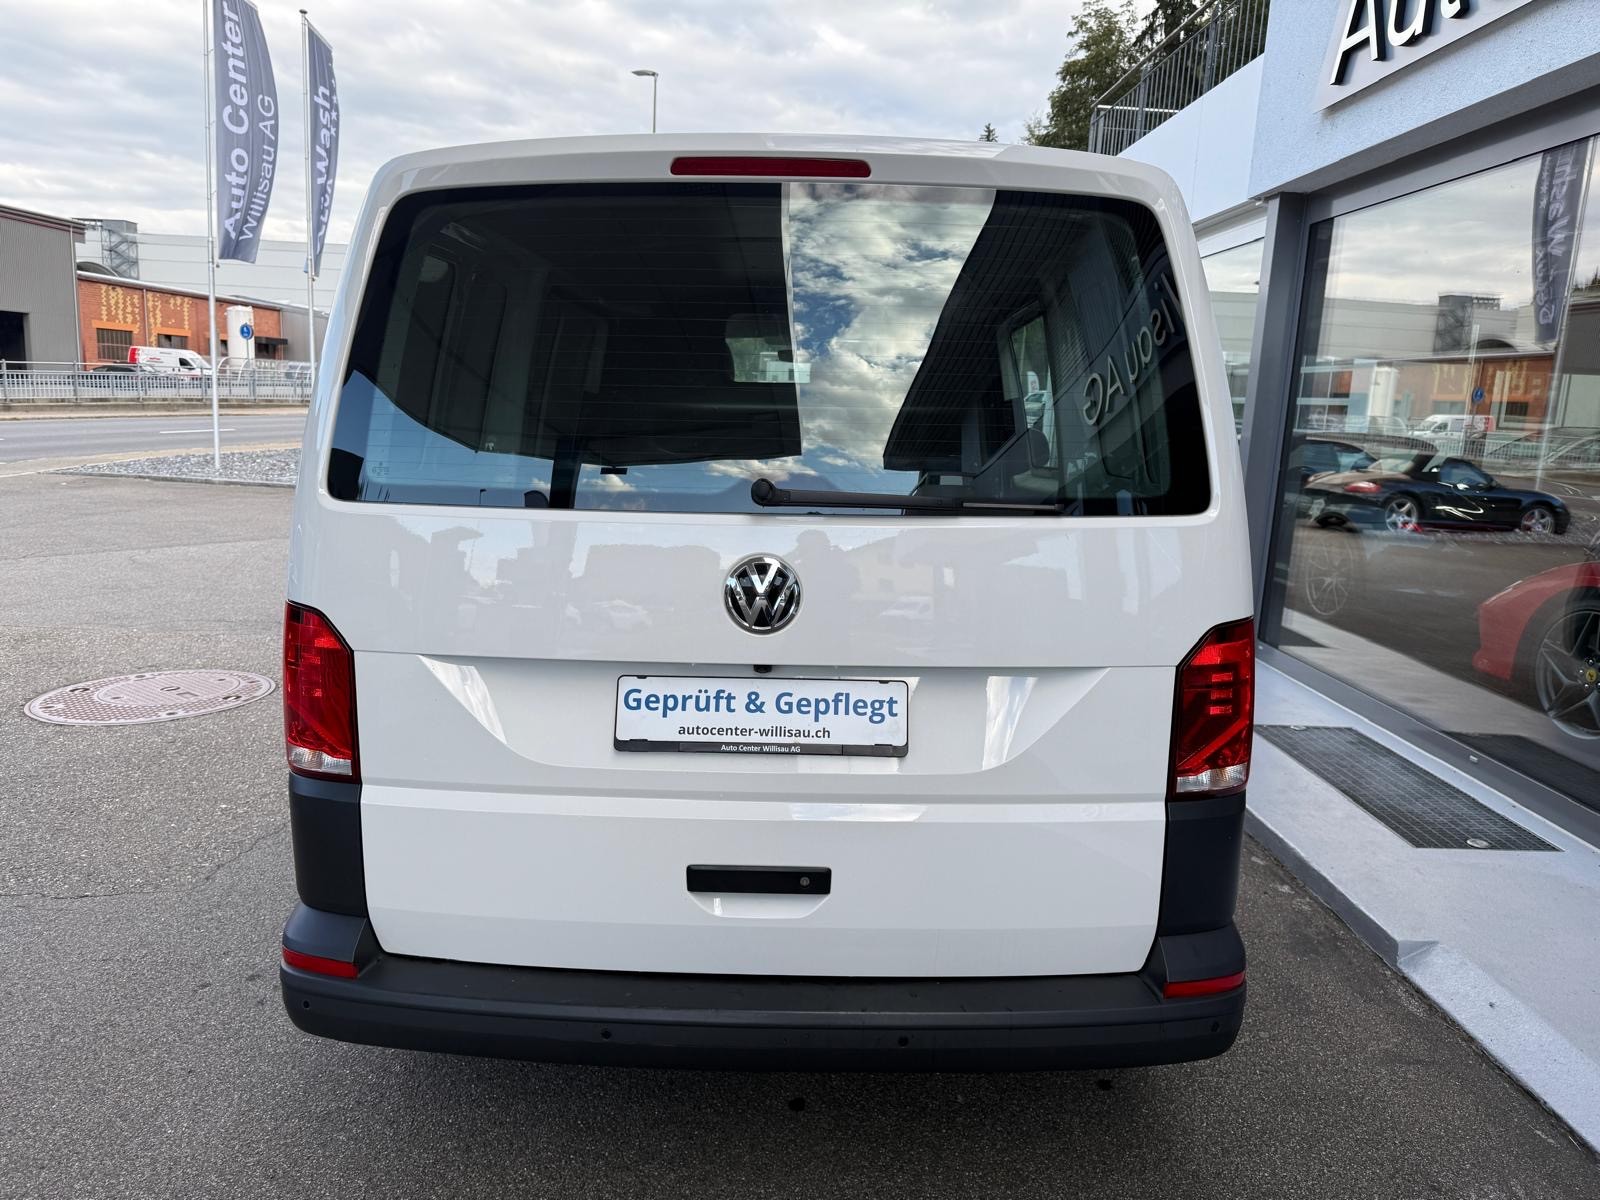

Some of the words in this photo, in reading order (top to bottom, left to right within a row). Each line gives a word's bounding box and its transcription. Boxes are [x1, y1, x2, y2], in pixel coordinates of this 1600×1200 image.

[222, 0, 249, 135] Center
[238, 143, 275, 241] Willisau
[257, 93, 276, 140] AG
[313, 85, 330, 185] Wash
[224, 147, 250, 241] Auto
[623, 688, 736, 719] Geprüft
[744, 691, 766, 714] &
[775, 691, 899, 724] Gepflegt
[678, 724, 831, 740] autocenter-willisau.ch
[720, 744, 738, 752] Auto
[738, 744, 761, 752] Center
[762, 745, 788, 753] Willisau
[790, 745, 801, 753] AG
